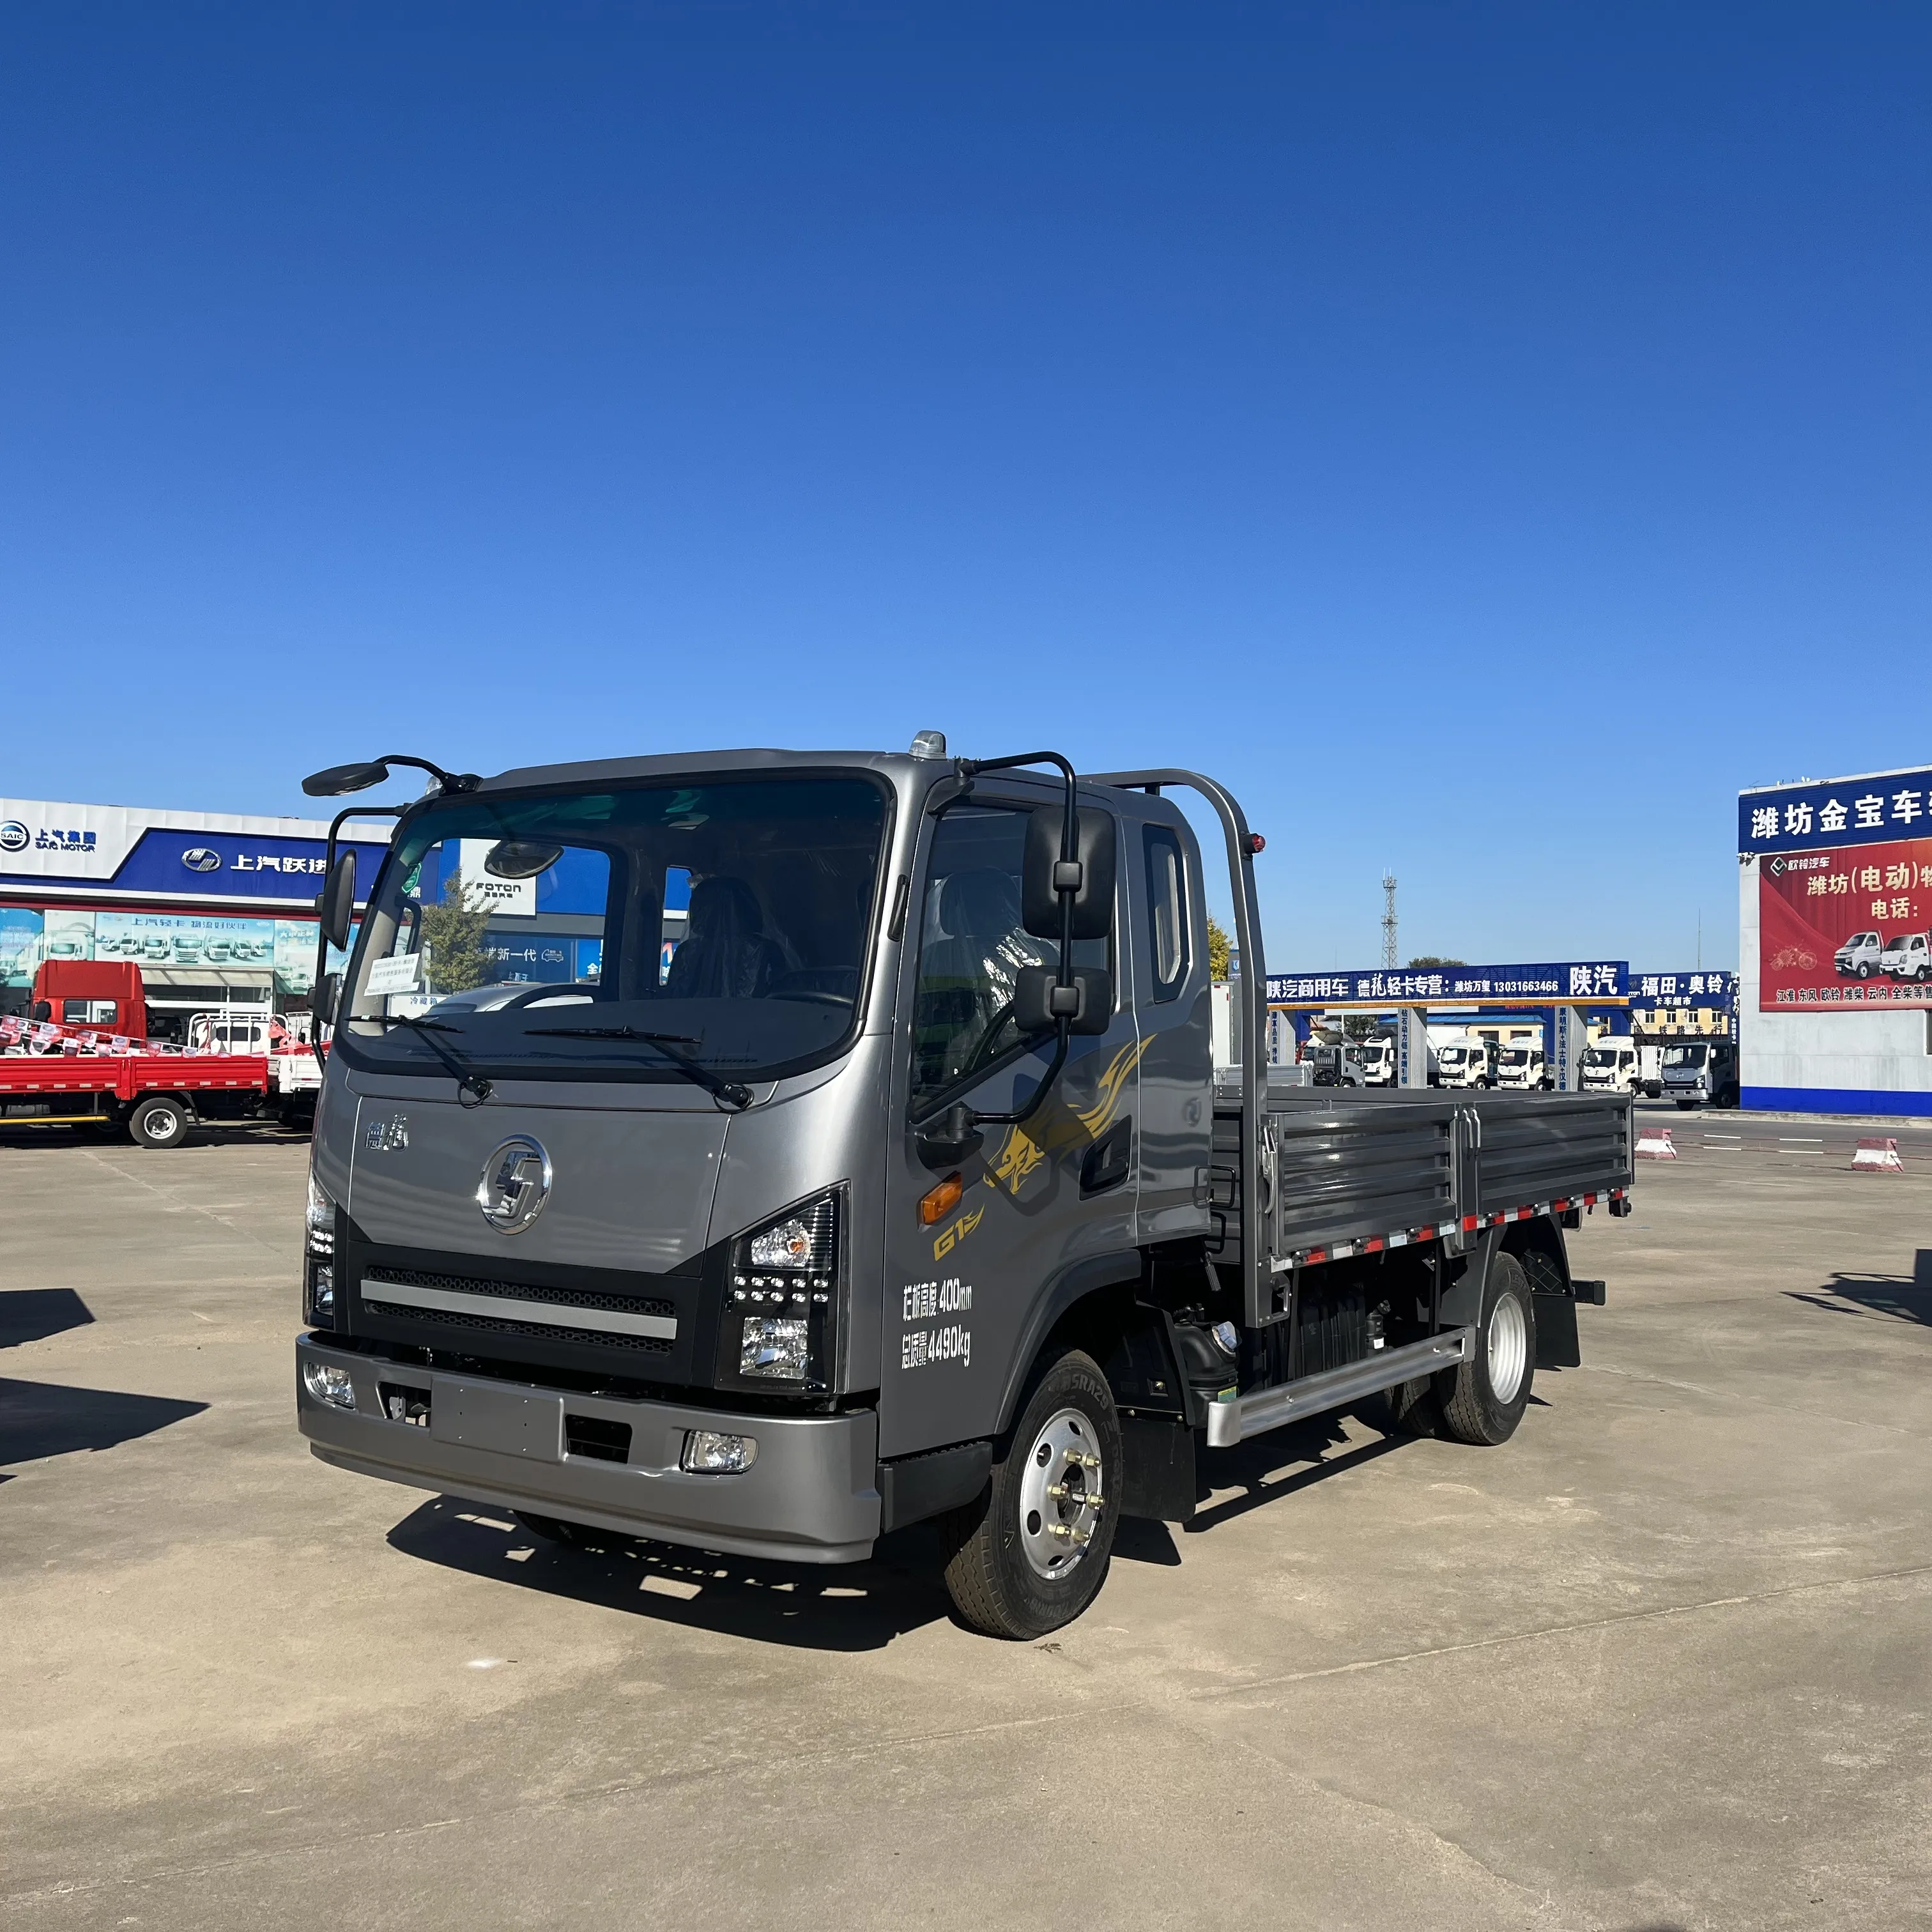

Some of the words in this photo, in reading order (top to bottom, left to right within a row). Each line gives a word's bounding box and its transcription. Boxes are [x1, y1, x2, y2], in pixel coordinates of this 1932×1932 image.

[1751, 790, 1932, 839] 潍坊金宝车
[35, 841, 58, 850] SAIC
[61, 843, 95, 852] MOTOR
[1788, 857, 1830, 871] 欧铃汽车
[476, 882, 521, 893] FOTON
[131, 917, 185, 927] 上汽轻卡
[586, 962, 602, 975] 全
[1266, 978, 1349, 999] 陕汽商用车
[1494, 980, 1559, 993] 13031663466
[1570, 965, 1618, 995] 陕汽
[1777, 990, 1795, 1002] 江淮
[1798, 988, 1817, 1002] 东风
[1820, 988, 1841, 1001] 欧铃
[1844, 986, 1864, 1000] 潍柴
[1868, 986, 1887, 1000] 云内
[1654, 996, 1692, 1006] 卡车超市
[1659, 1025, 1723, 1035] 铁路先行
